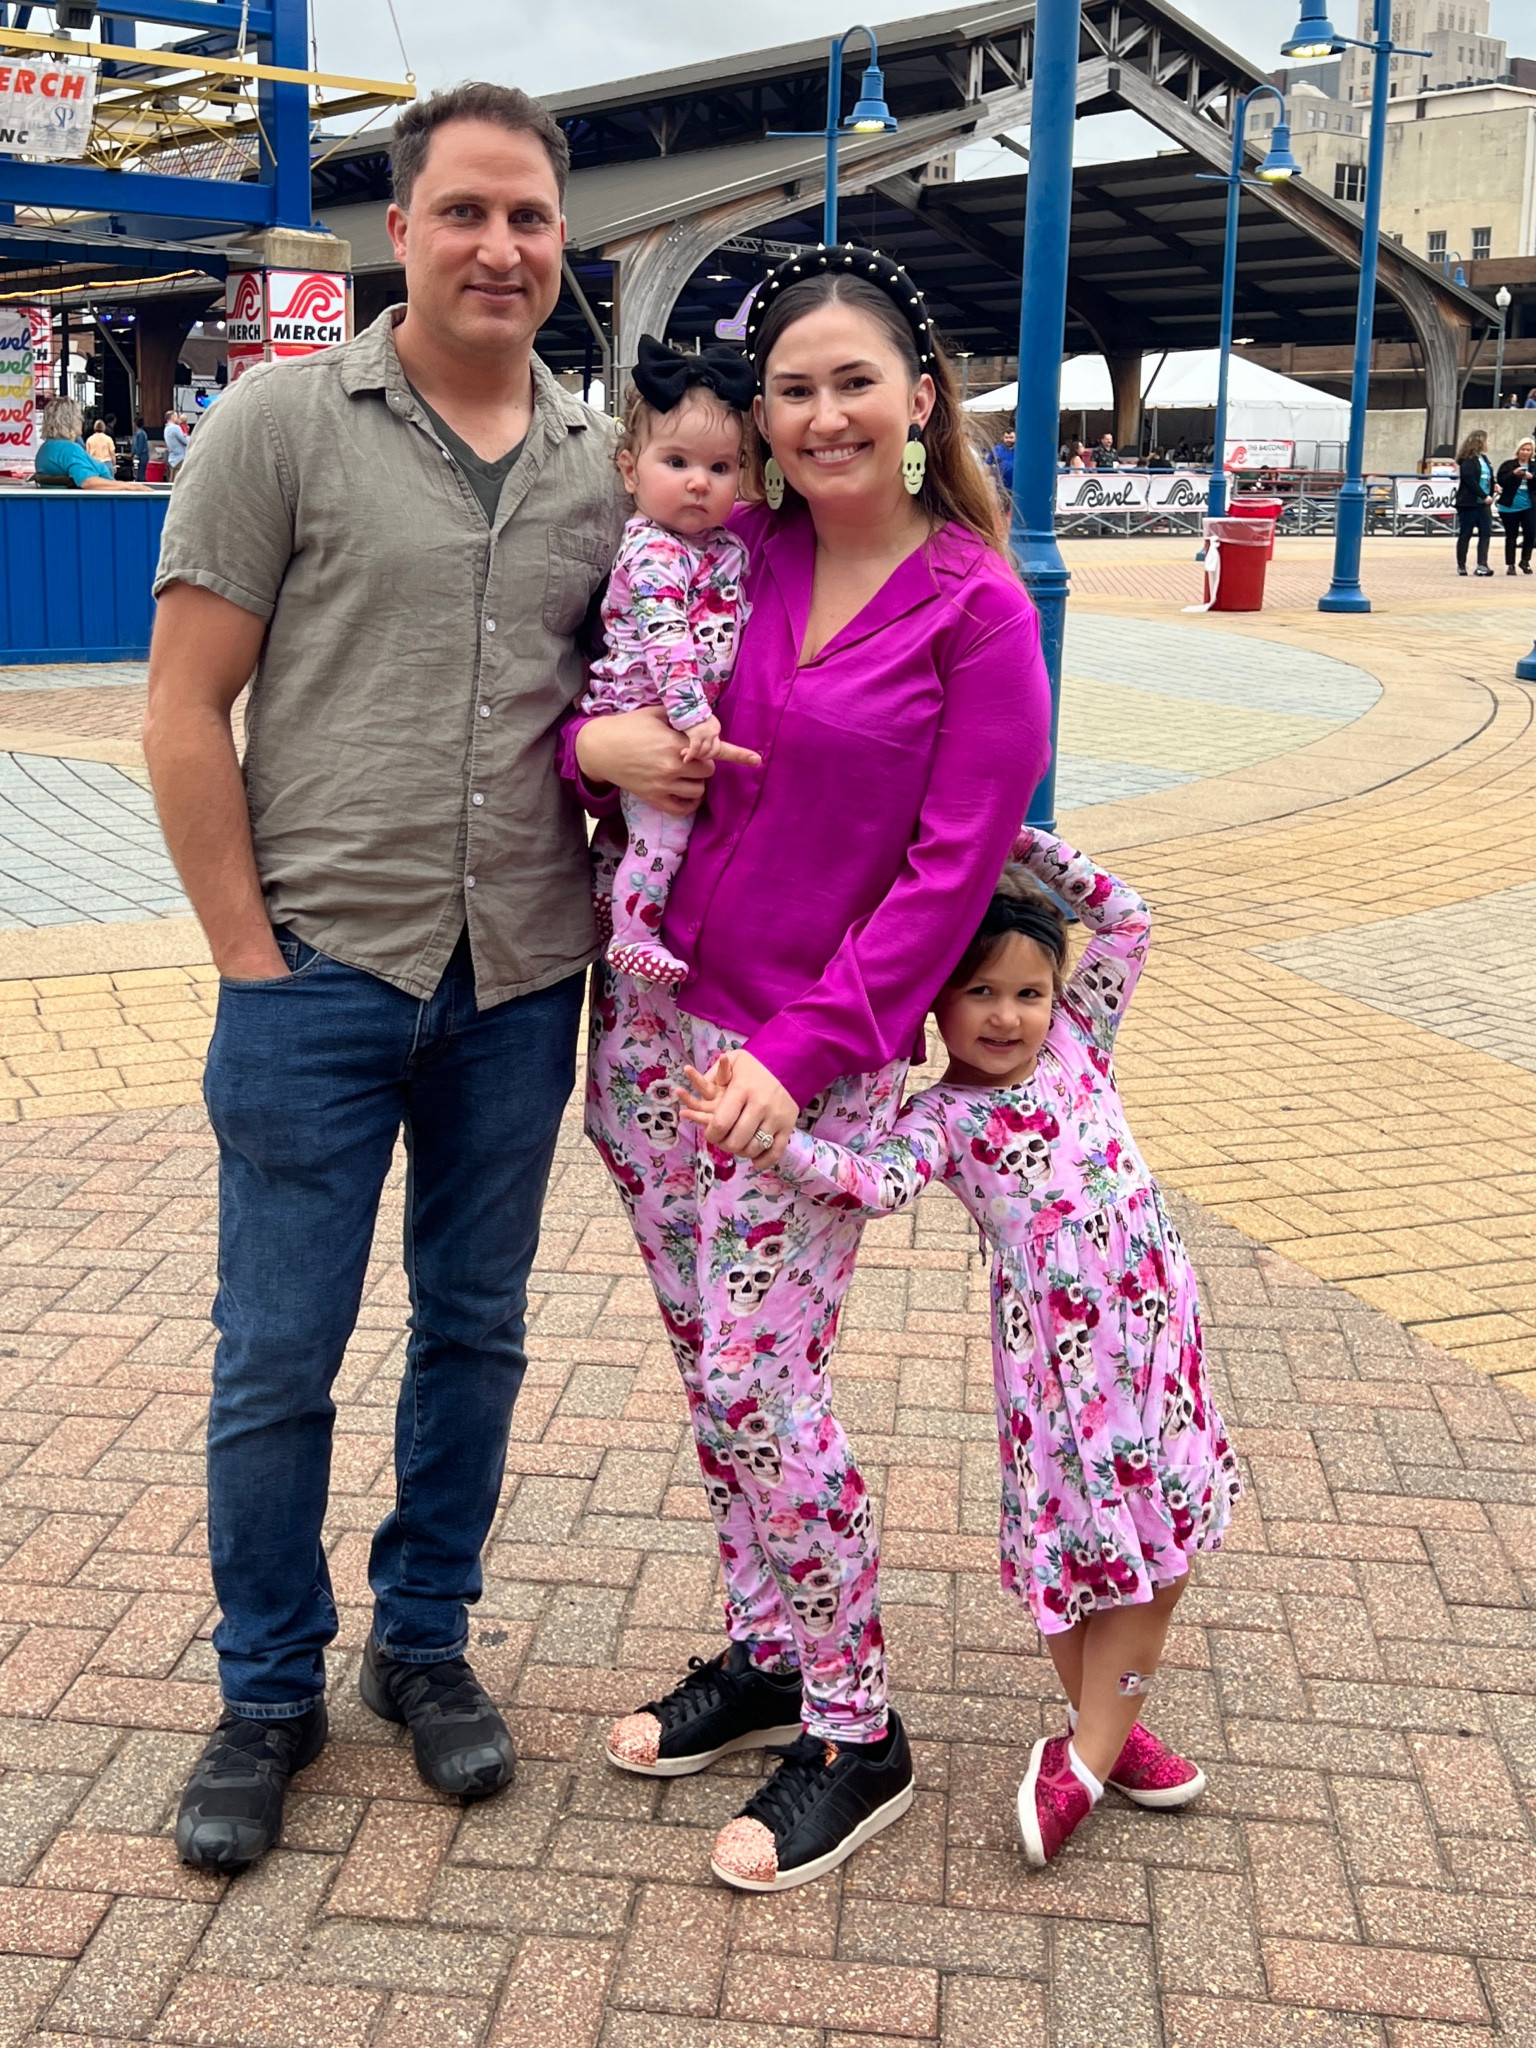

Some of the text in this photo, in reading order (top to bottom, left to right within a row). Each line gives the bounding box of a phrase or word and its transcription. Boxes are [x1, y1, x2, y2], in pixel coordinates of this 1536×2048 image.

[228, 324, 260, 340] MERCH
[273, 323, 342, 342] MERCH
[1066, 479, 1141, 508] Revel
[1157, 479, 1209, 507] Reve
